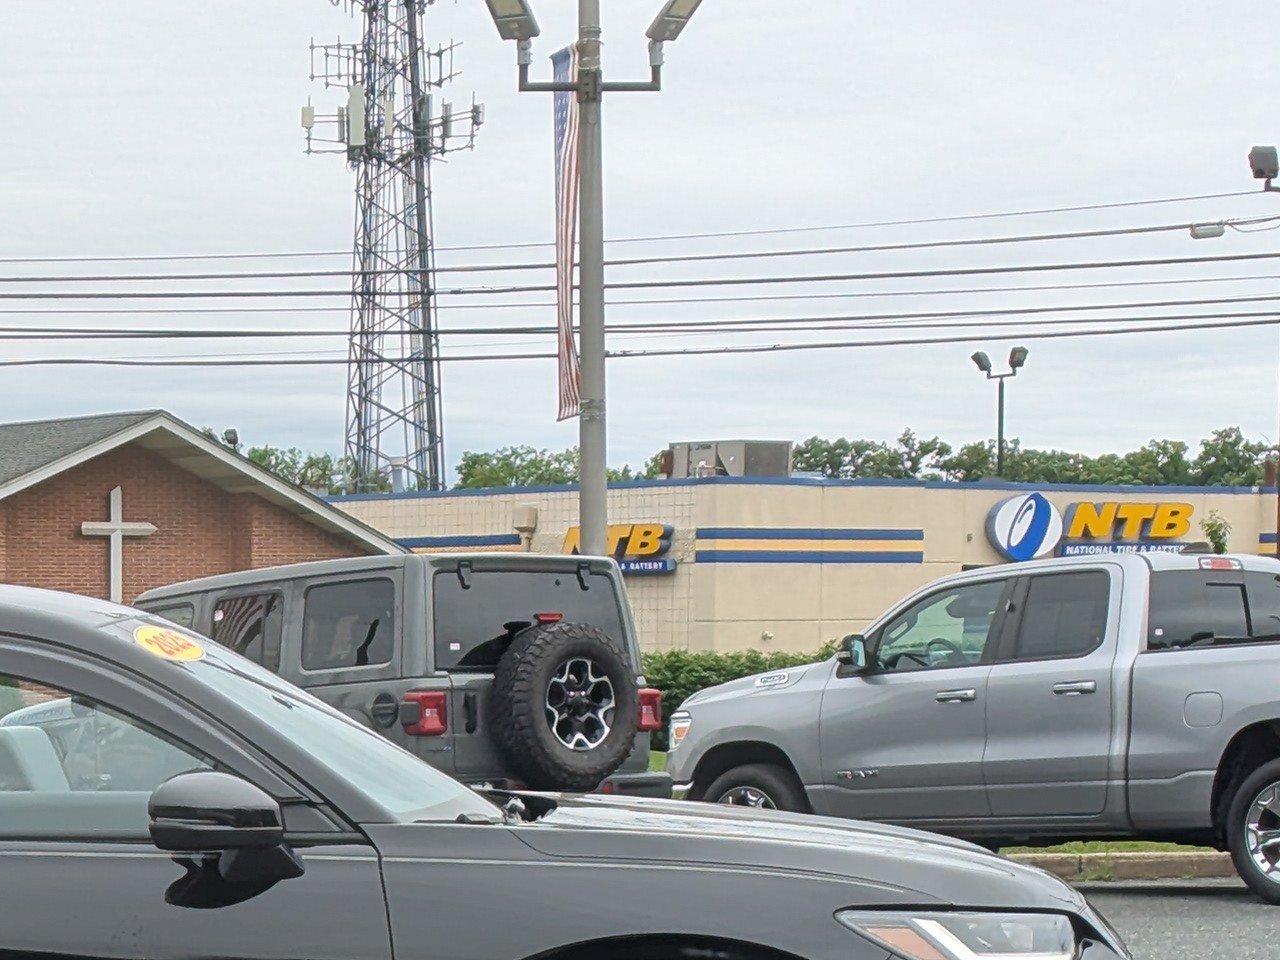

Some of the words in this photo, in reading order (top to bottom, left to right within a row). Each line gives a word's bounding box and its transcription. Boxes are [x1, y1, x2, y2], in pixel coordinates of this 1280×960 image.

[1067, 502, 1194, 538] NTB
[1066, 545, 1113, 555] NATIONAL
[629, 561, 664, 570] BATTERY
